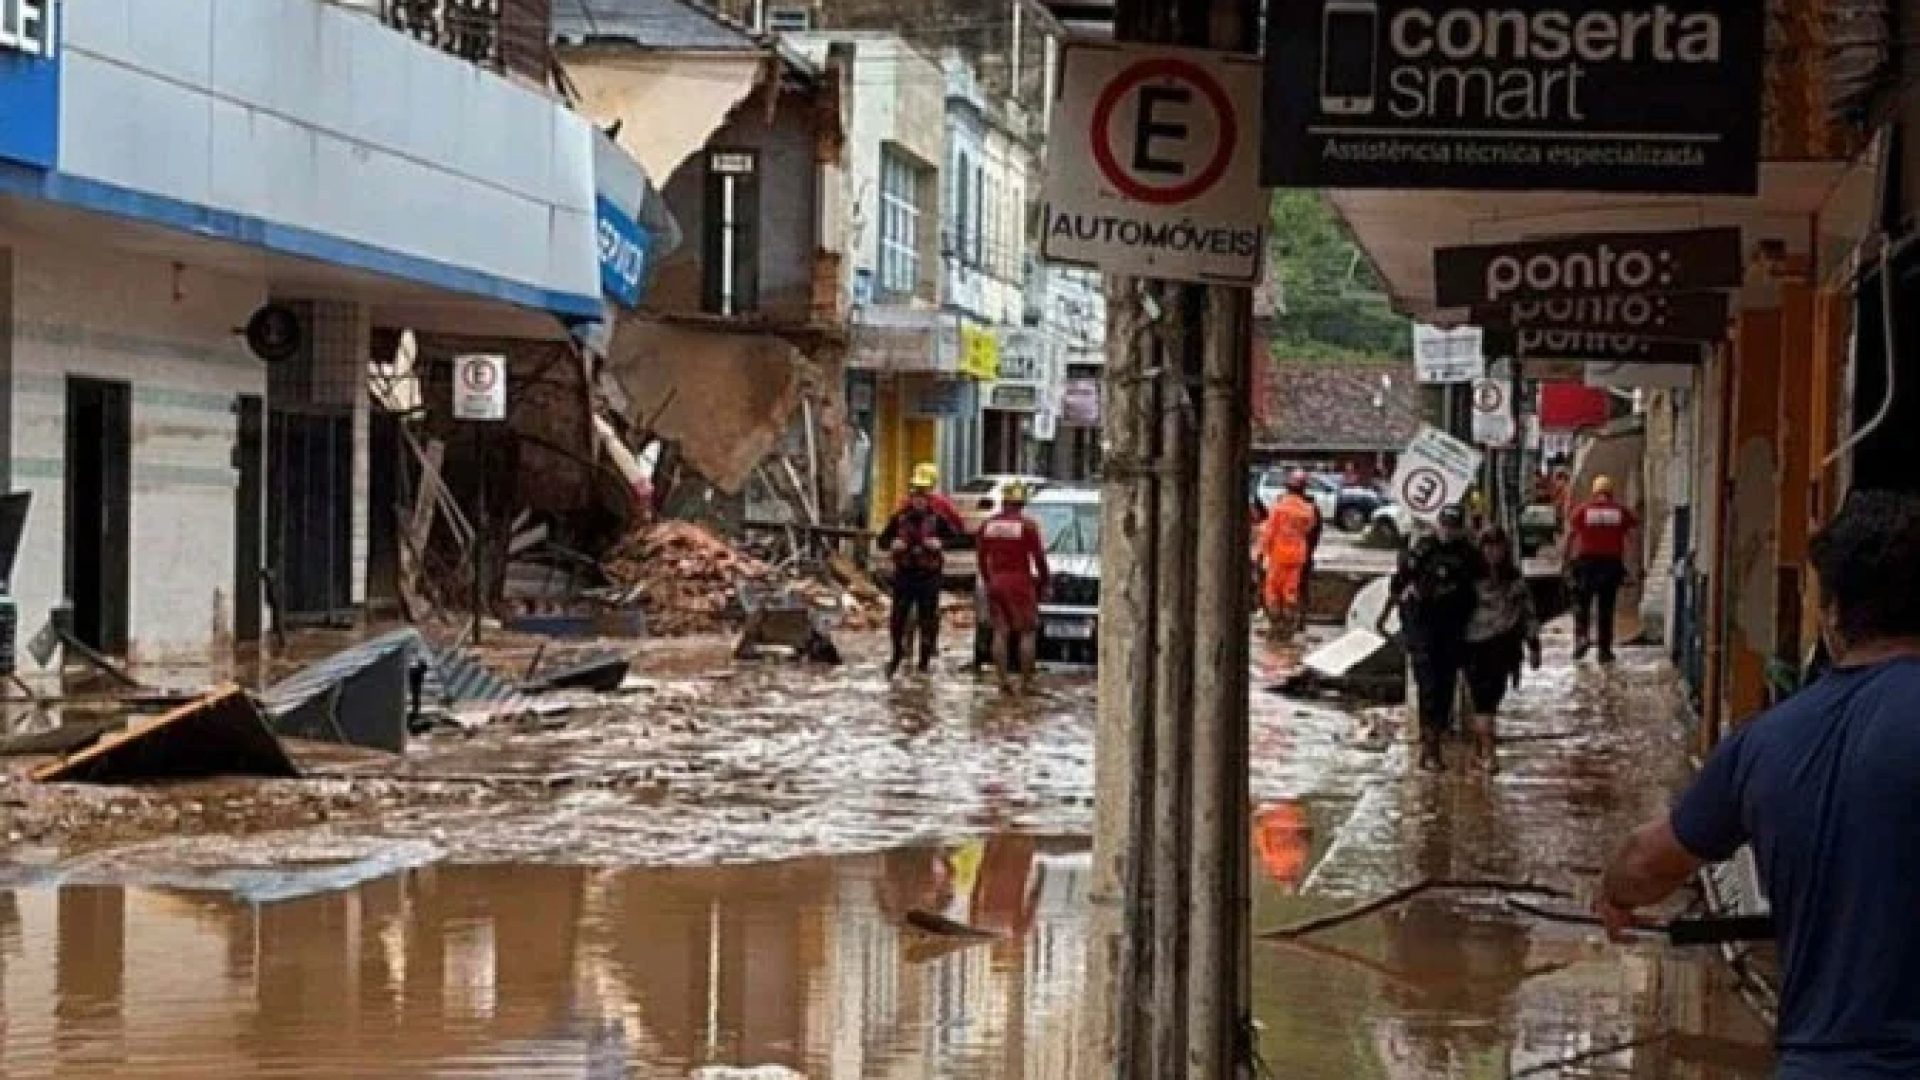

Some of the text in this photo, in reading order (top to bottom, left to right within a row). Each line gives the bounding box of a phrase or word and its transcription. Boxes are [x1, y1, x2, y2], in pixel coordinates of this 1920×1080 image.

[1390, 5, 1721, 62] conserta
[1388, 62, 1585, 120] smart
[1133, 85, 1192, 174] E
[1322, 138, 1705, 167] Assistência técnica especializada
[1053, 212, 1255, 256] AUTOMÓVEIS
[1487, 244, 1671, 300] ponto:
